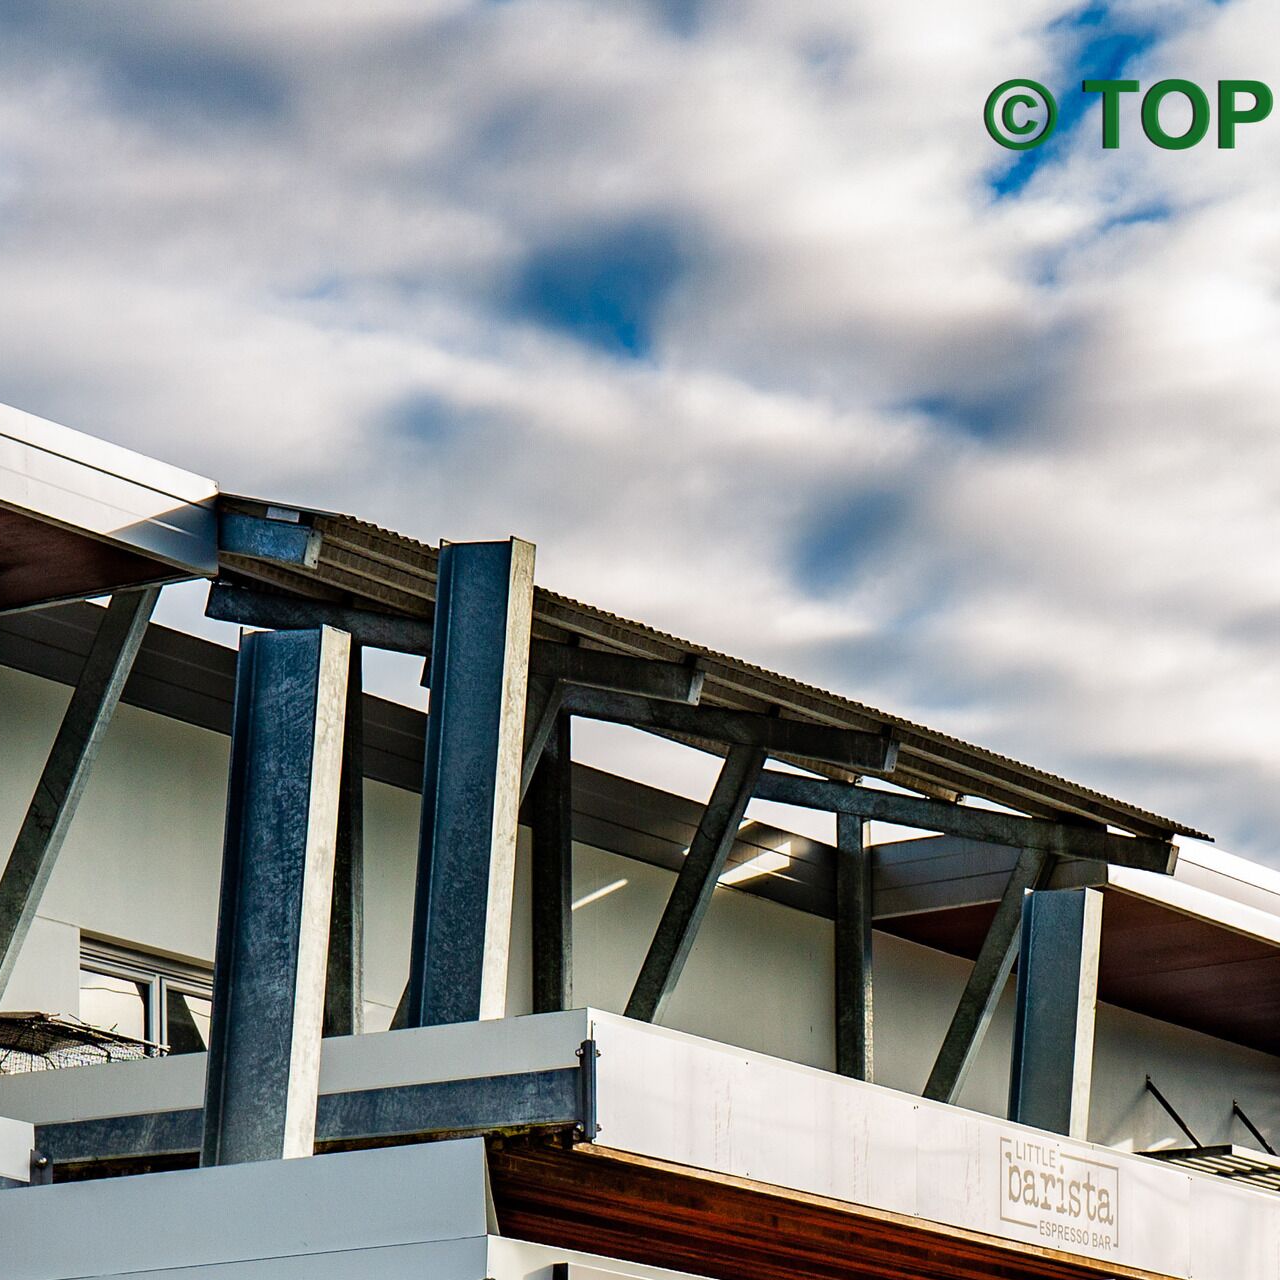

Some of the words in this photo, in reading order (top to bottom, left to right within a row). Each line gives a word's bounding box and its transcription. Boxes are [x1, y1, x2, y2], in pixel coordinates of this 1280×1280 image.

[1016, 1140, 1056, 1168] LITTLE
[1005, 1151, 1114, 1226] barista
[1040, 1220, 1089, 1246] ESPRESSO
[1092, 1233, 1112, 1251] BAR
